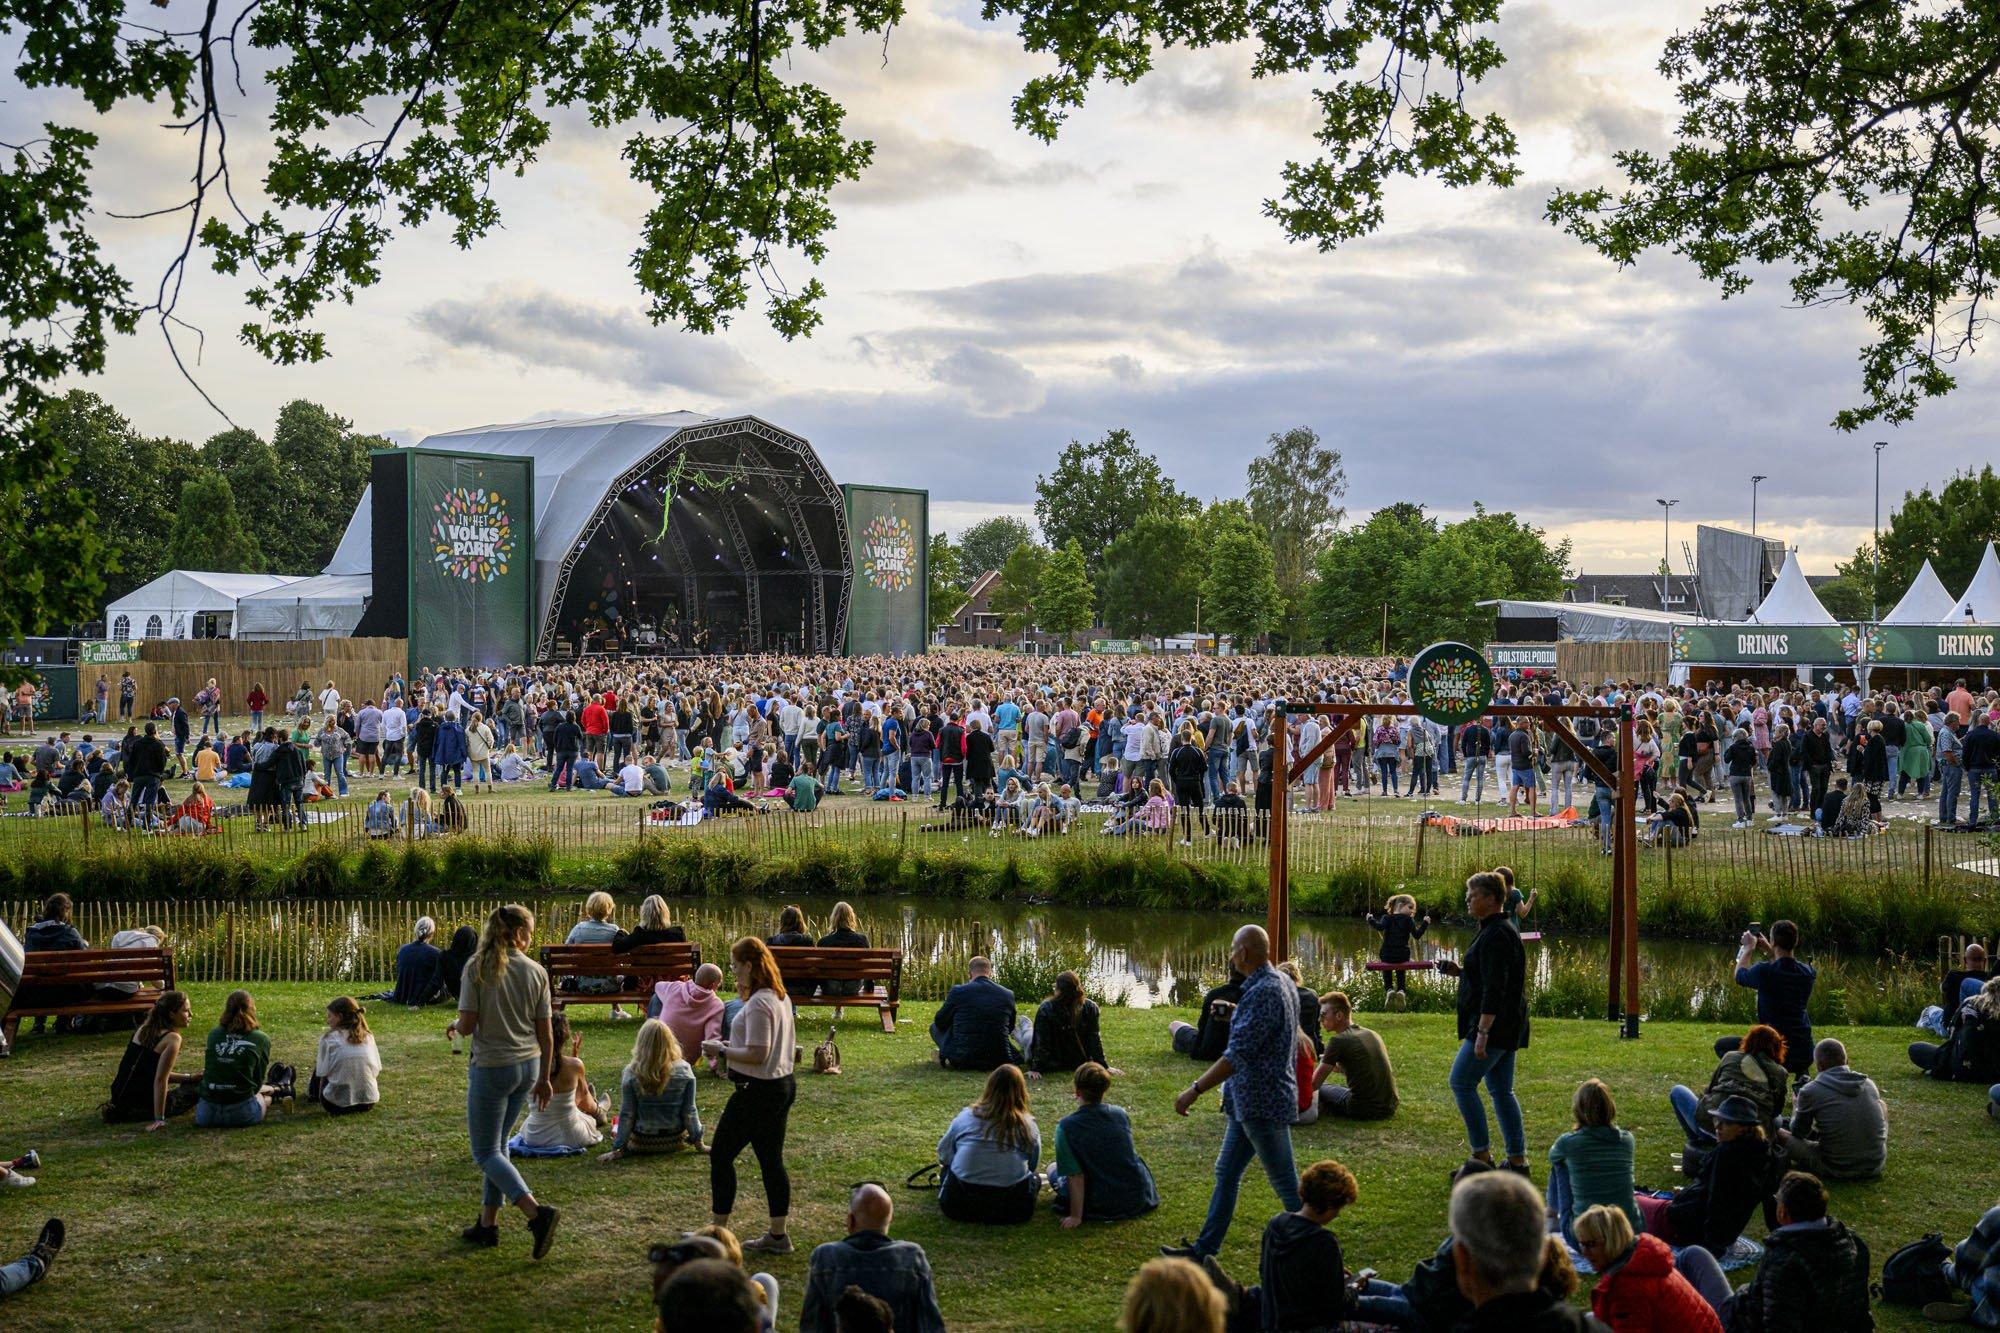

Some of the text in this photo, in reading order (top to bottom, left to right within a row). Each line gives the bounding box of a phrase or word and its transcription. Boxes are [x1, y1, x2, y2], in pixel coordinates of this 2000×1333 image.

[473, 515, 488, 527] HET
[449, 525, 499, 542] VOLKS
[453, 541, 495, 557] PARK
[873, 546, 907, 559] VOLKS
[877, 559, 904, 572] PARK
[100, 644, 121, 653] NOOD
[1738, 634, 1788, 655] DRINKS
[1938, 634, 1994, 656] DRINKS
[93, 653, 128, 661] UITGANG
[1498, 651, 1557, 663] ROLSTOELPODIU
[1432, 680, 1472, 690] VOLKS
[1436, 689, 1469, 699] PARK
